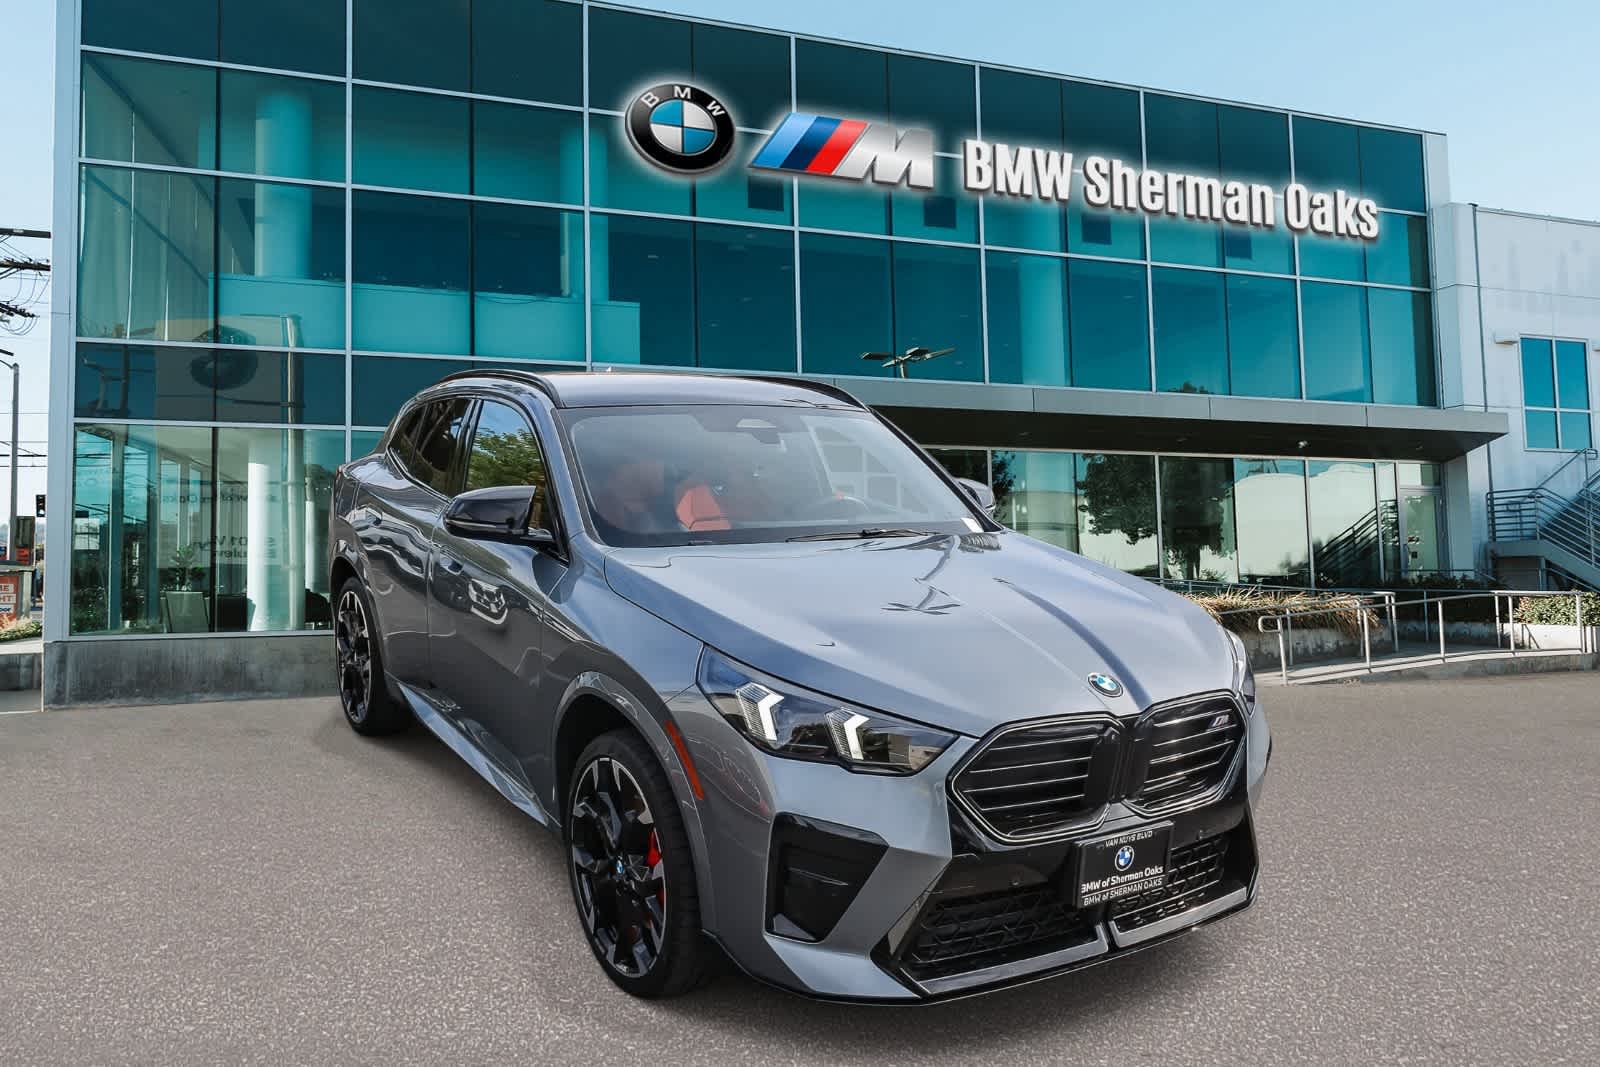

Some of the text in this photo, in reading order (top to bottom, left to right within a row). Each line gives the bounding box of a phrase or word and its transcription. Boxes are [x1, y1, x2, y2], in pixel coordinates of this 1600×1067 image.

[641, 85, 726, 117] BMW
[963, 139, 1379, 240] BMW Sherman Oaks
[1105, 831, 1152, 847] VAN NUYS BLVD
[1081, 866, 1163, 893] BMW of Sherman Oaks
[1084, 894, 1101, 905] BMW
[1110, 882, 1142, 898] SHERMAN
[1144, 878, 1162, 889] OAKS
